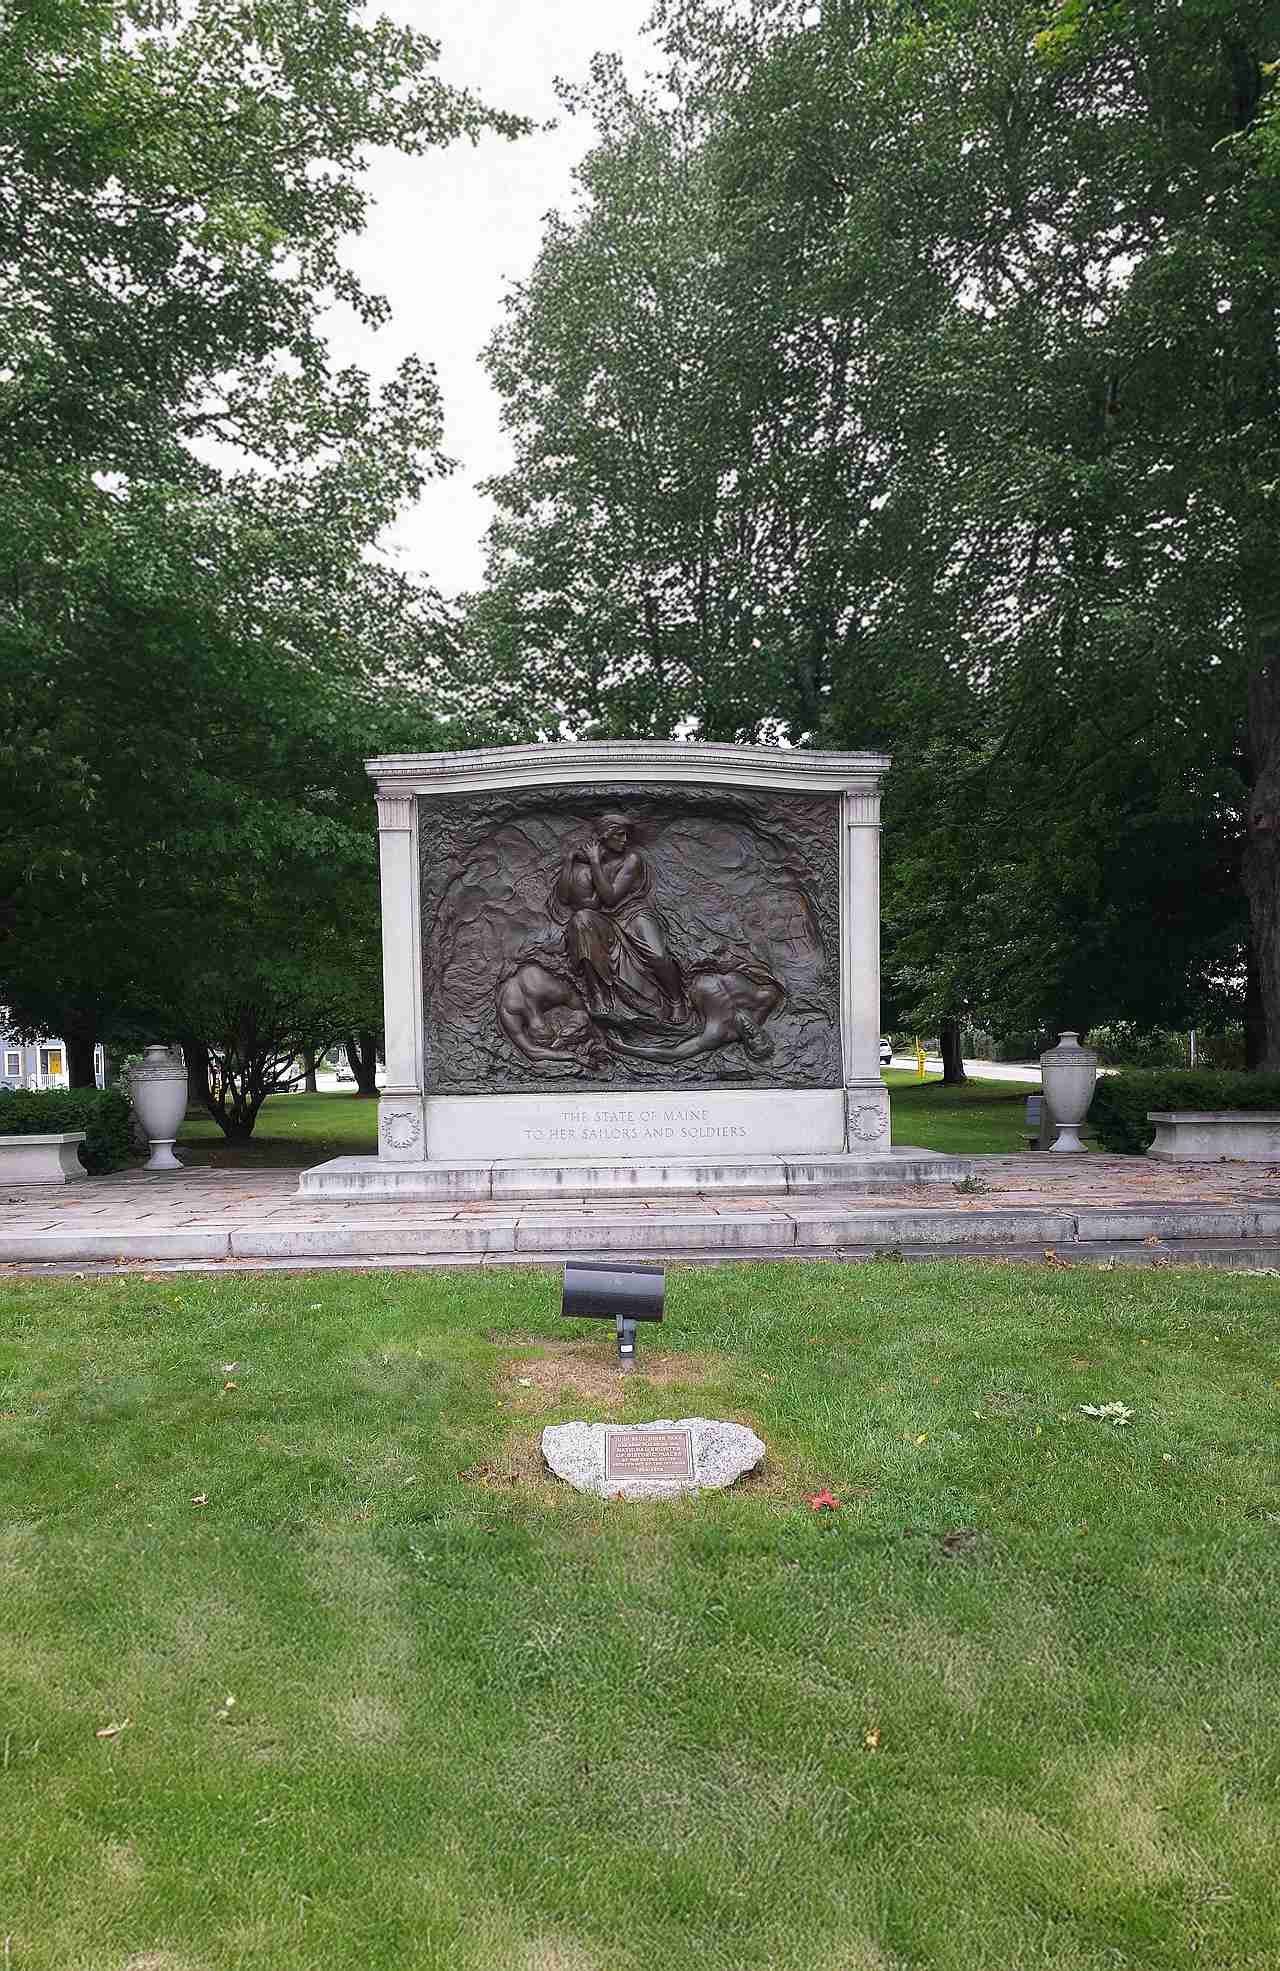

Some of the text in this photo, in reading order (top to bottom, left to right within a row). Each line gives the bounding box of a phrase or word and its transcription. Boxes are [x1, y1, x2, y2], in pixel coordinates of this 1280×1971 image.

[560, 1110, 709, 1121] THE STATE OF MAINE
[523, 1126, 747, 1139] TO HER SAILORS AND SOLDIERS
